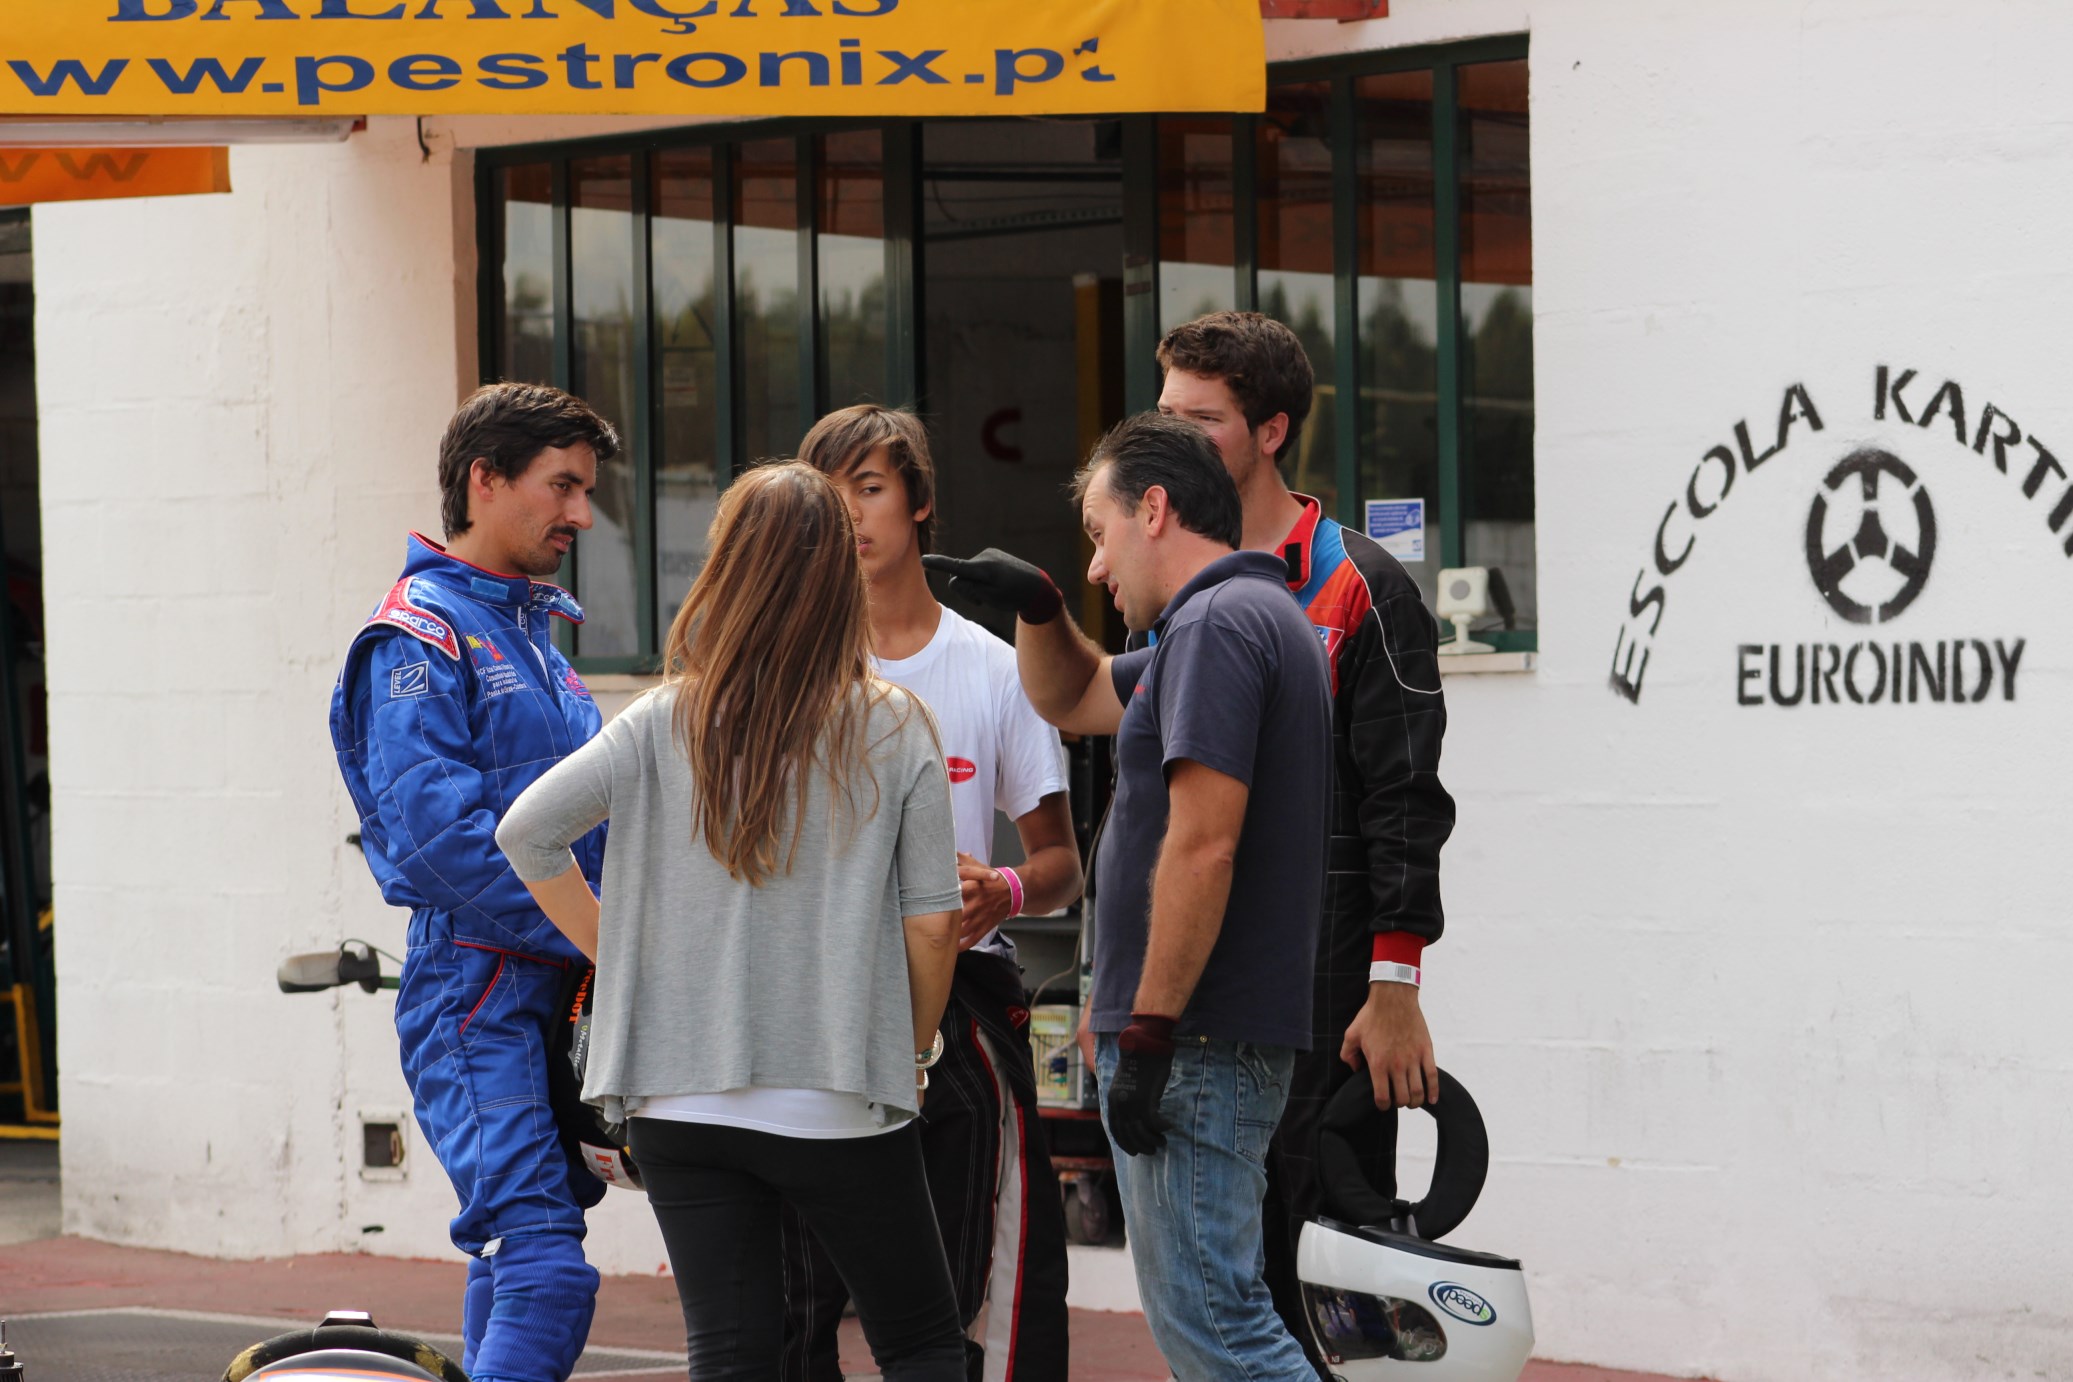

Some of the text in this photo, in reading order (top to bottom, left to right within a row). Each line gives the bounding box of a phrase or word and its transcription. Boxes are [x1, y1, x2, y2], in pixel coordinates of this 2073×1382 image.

[1608, 364, 2073, 705] ESCOLA KARTI
[389, 609, 446, 638] sparco
[393, 671, 402, 694] LEVEL
[401, 666, 425, 693] 2
[1736, 638, 2026, 706] EUROINDY
[1443, 1288, 1490, 1320] speed
